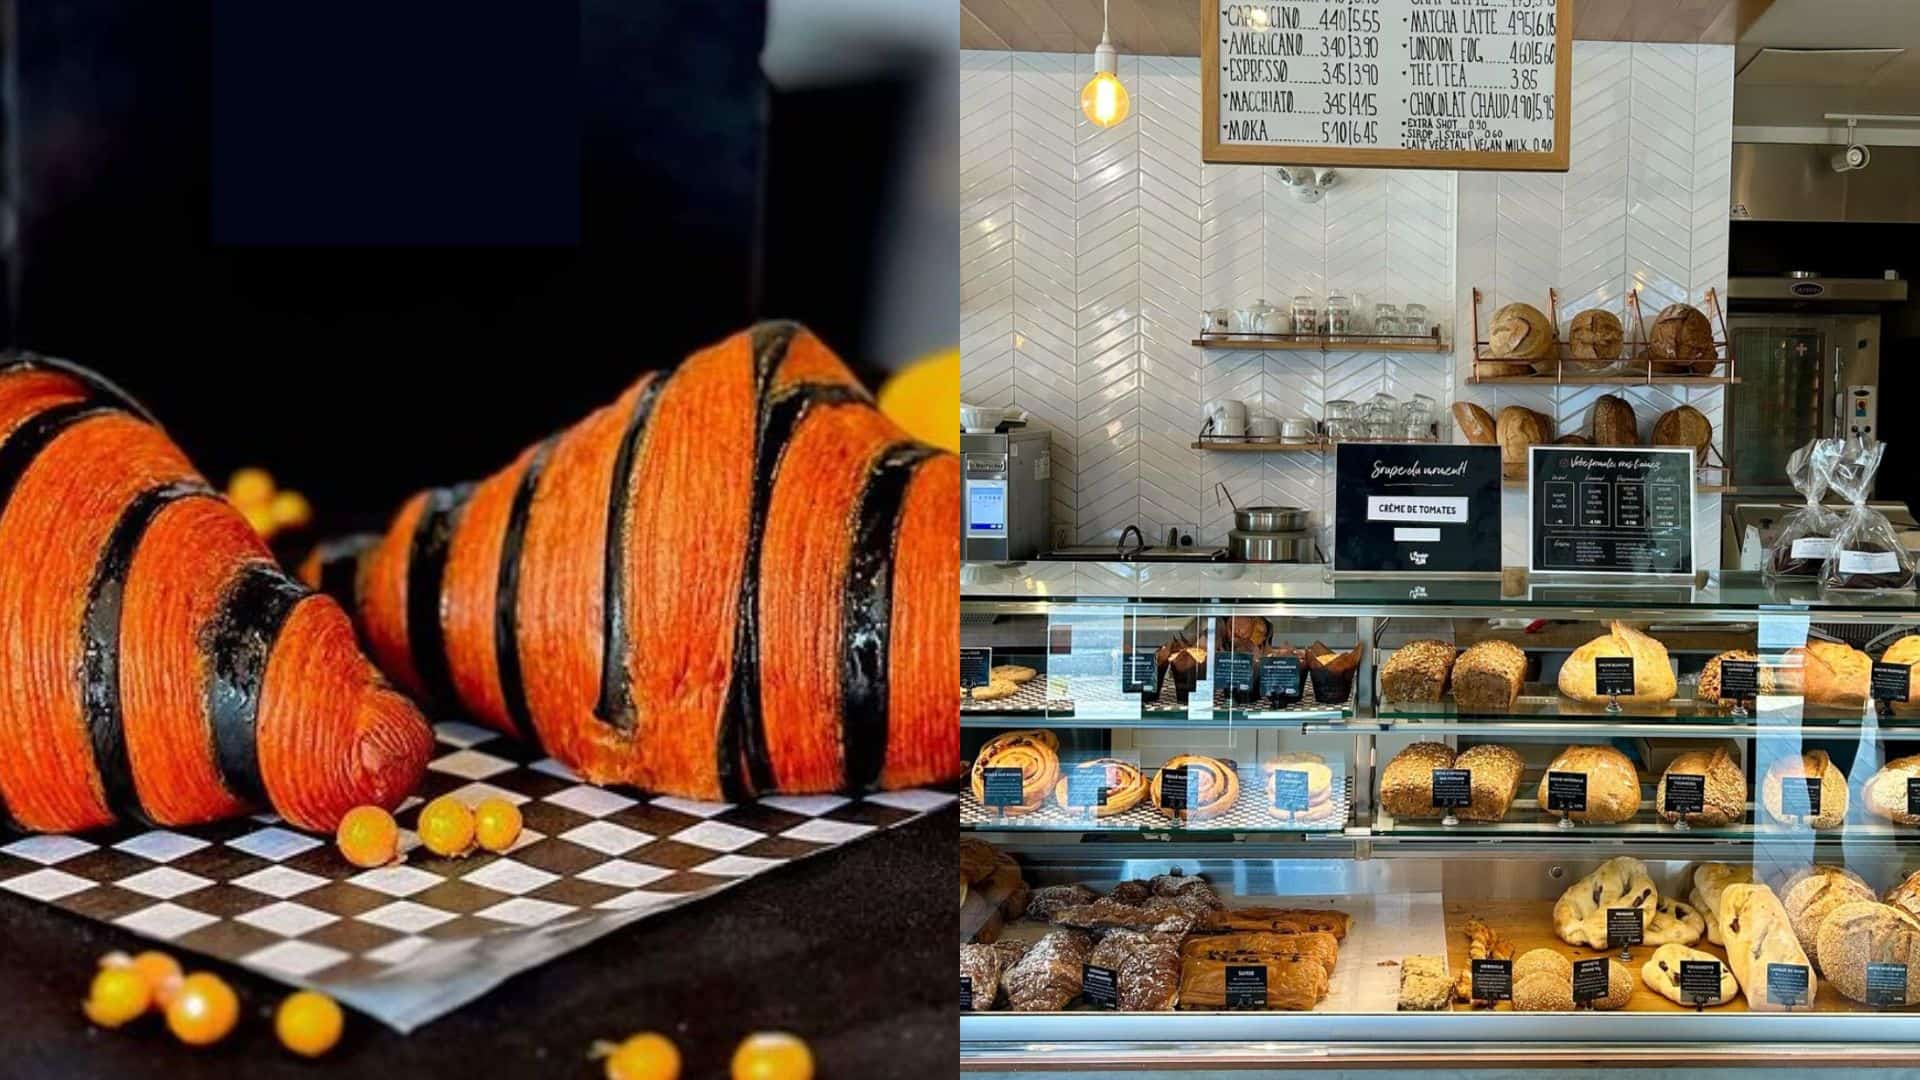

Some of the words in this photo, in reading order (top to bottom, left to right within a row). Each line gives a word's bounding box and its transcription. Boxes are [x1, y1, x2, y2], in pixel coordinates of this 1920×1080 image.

[1228, 4, 1300, 29] CAPCCINO
[1410, 9, 1458, 34] MATCHA
[1463, 9, 1498, 35] LATTE
[1229, 32, 1303, 56] AMERICANO
[1409, 36, 1454, 62] LONDON
[1461, 37, 1484, 63] FOG
[1229, 58, 1288, 83] ESPRESSO
[1229, 90, 1294, 113] MACCHIATO
[1409, 91, 1466, 118] CHOCOLAT
[1471, 91, 1510, 119] CHAUD
[1228, 119, 1269, 141] MOKA
[1407, 118, 1434, 129] EXTRA
[1436, 118, 1458, 129] SHOT
[1407, 129, 1433, 139] SIROP
[1505, 139, 1528, 152] MILK
[1407, 505, 1419, 513] DE
[1419, 505, 1457, 515] TOMATES
